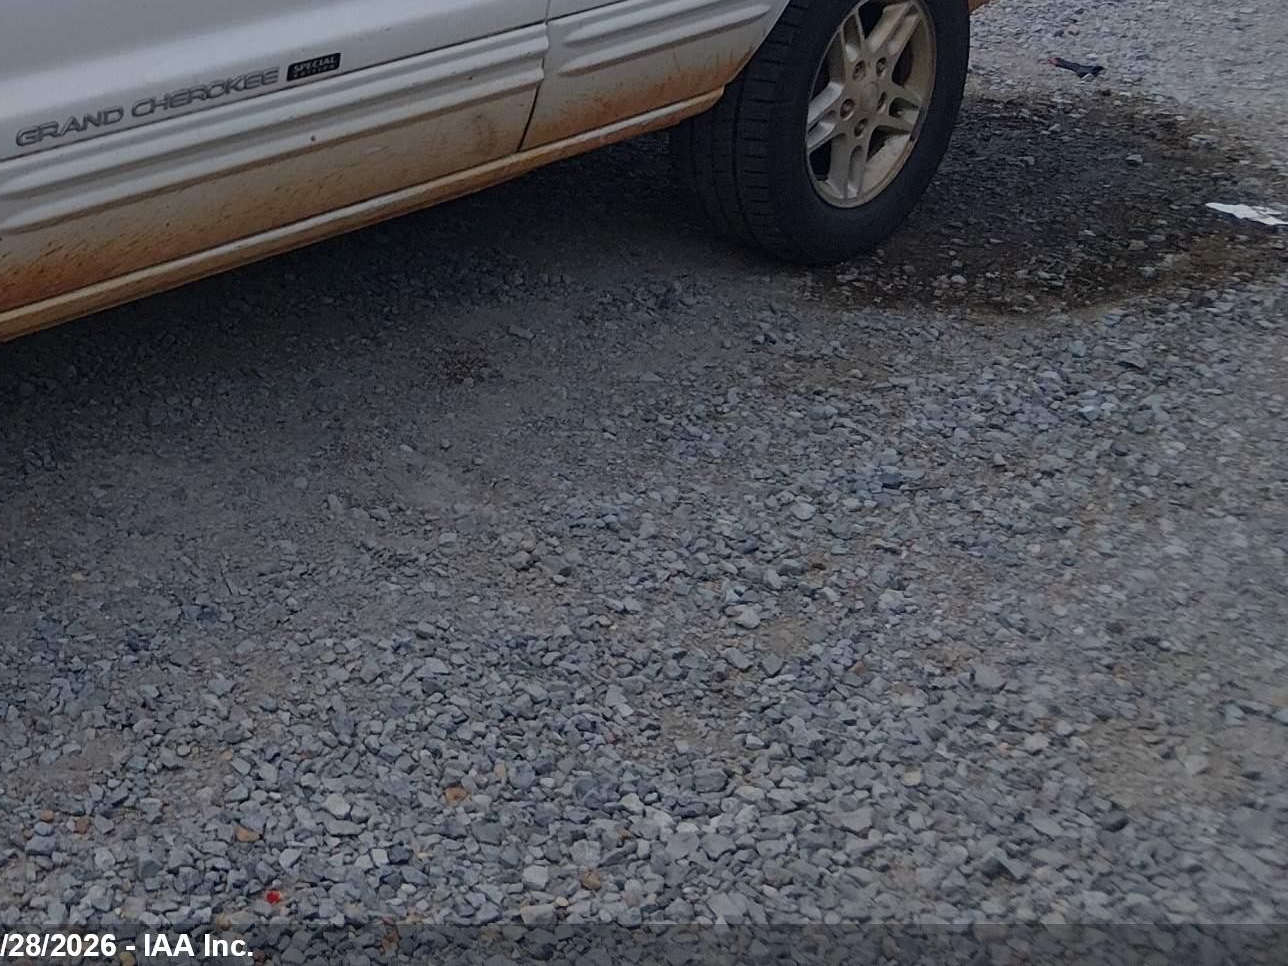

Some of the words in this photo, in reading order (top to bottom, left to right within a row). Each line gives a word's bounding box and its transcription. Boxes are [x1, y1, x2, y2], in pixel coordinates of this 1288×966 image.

[294, 56, 337, 72] SPECIAL
[15, 106, 124, 147] GRAND
[131, 66, 280, 118] CHEROKEE
